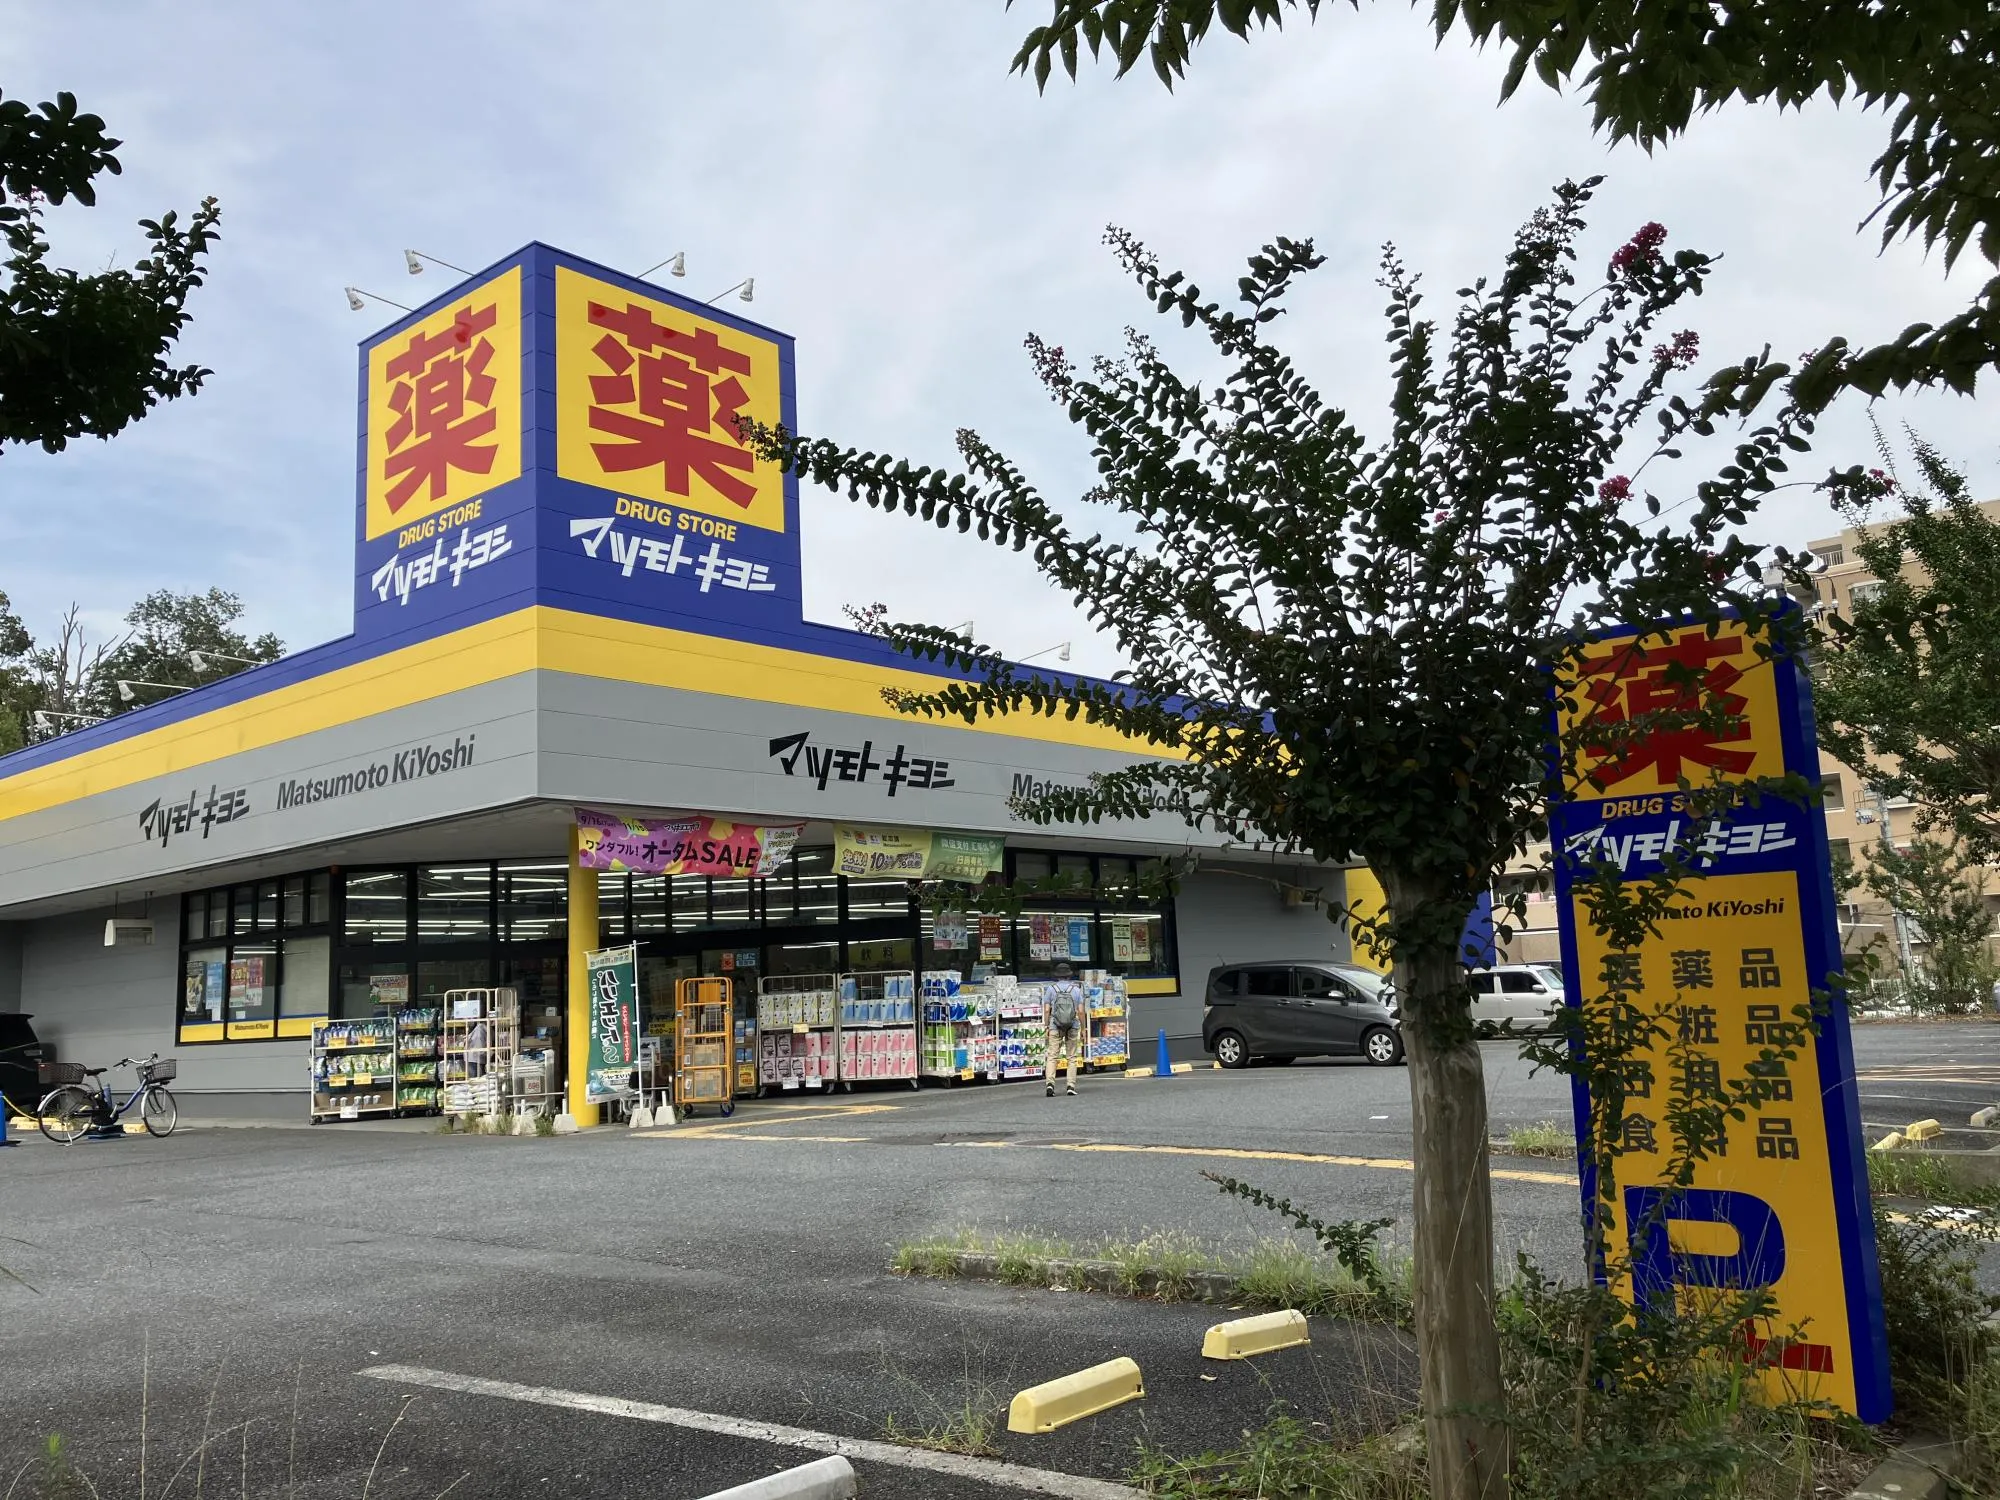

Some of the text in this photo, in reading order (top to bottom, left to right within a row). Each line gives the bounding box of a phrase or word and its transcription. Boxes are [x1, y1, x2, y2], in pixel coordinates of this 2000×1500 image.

[385, 303, 499, 515] 薬
[587, 300, 758, 510] 薬
[398, 499, 483, 549] DRUG STORE
[615, 497, 737, 542] DRUG STORE
[371, 524, 513, 606] マツモトキヨシ
[569, 516, 777, 593] マツモトキヨシ
[1578, 631, 1758, 786] 薬
[277, 735, 476, 810] Matsumoto KiYoshi
[769, 731, 956, 797] マツモトキヨシ
[139, 784, 250, 848] マツモトキヨシ
[1602, 798, 1664, 819] DRUG
[1564, 820, 1797, 873] マツモトキヨシ
[1707, 898, 1784, 918] KiYoshi
[1600, 948, 1781, 993] 医薬品
[1621, 1112, 1800, 1160] 食品
[1623, 1185, 1786, 1337] P
